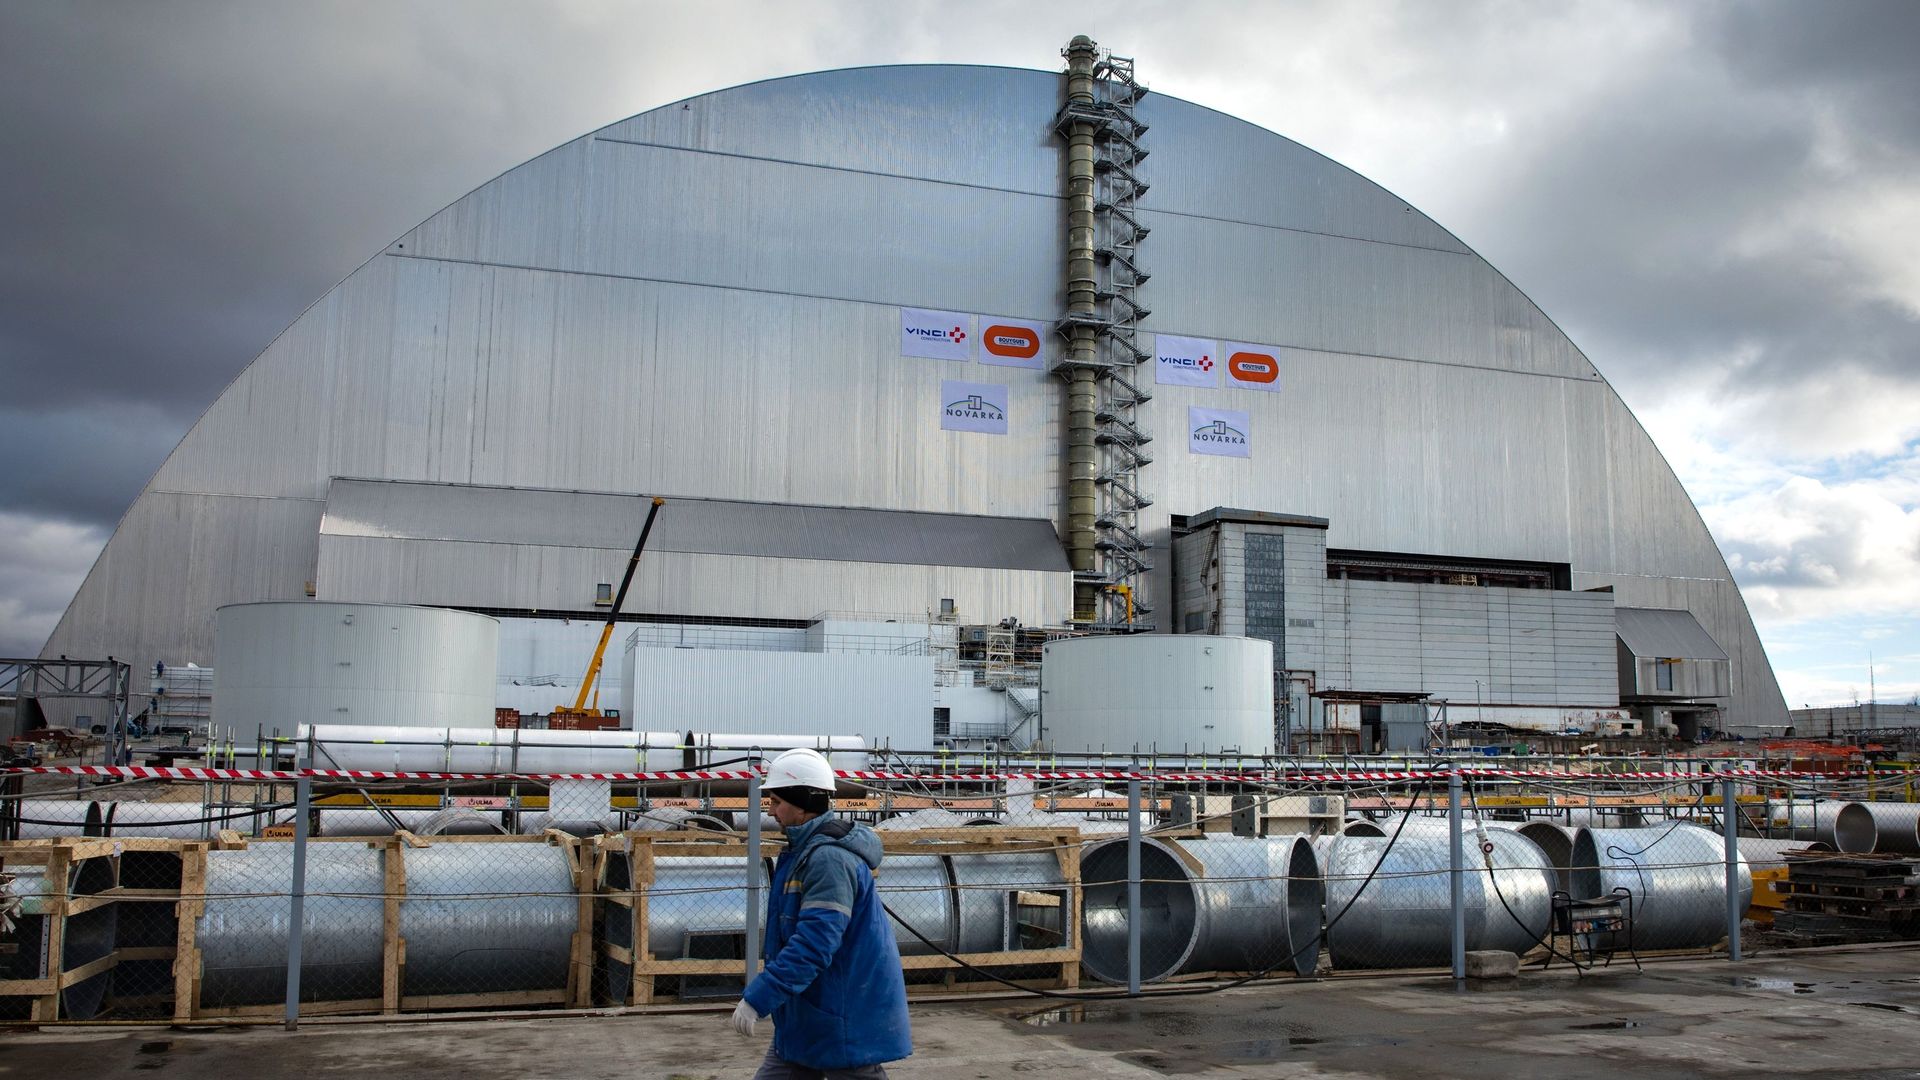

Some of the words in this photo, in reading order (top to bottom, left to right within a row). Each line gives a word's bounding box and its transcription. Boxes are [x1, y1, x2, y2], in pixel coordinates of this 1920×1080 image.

[906, 327, 946, 337] VINCI
[1160, 357, 1195, 366] VINCI
[946, 408, 1003, 420] NOVARKA
[1193, 433, 1245, 444] NOVARKA
